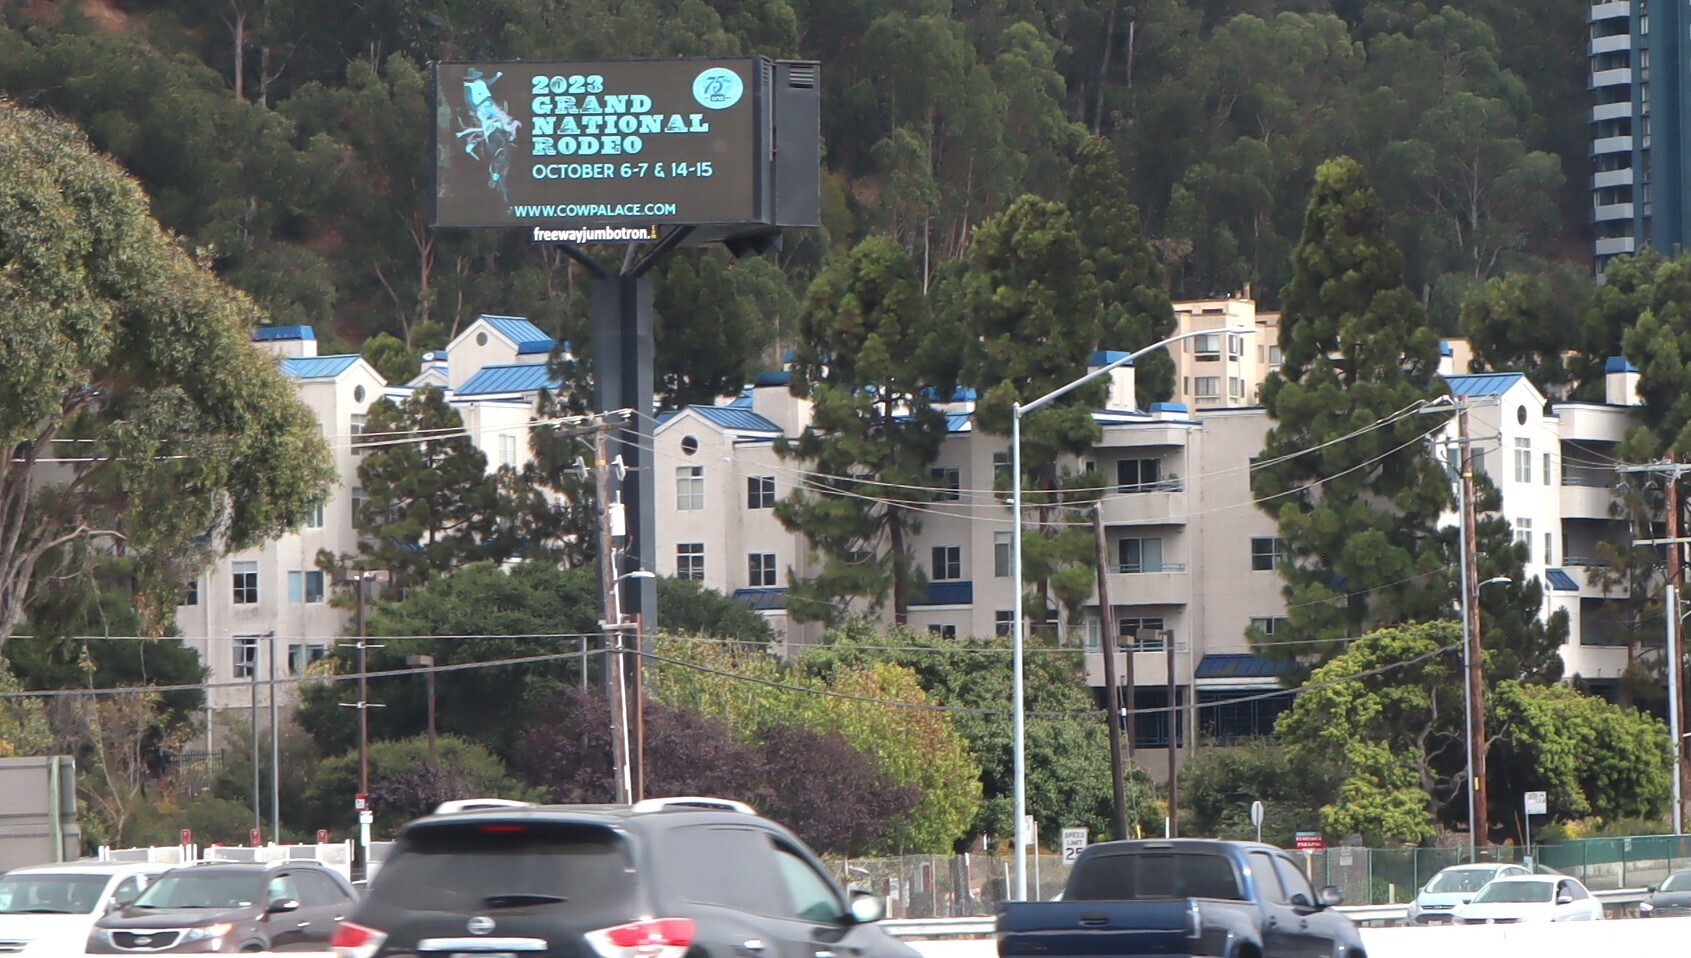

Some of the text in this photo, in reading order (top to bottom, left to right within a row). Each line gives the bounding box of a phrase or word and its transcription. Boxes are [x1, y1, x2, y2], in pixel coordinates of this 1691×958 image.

[531, 75, 604, 94] 2023
[531, 94, 652, 114] GRAND
[531, 114, 710, 135] NATIONAL
[532, 135, 643, 155] RODEO
[532, 162, 713, 179] OCTOBER 6-7 & 14-15
[514, 203, 677, 217] WWW.COWPALACE.COM
